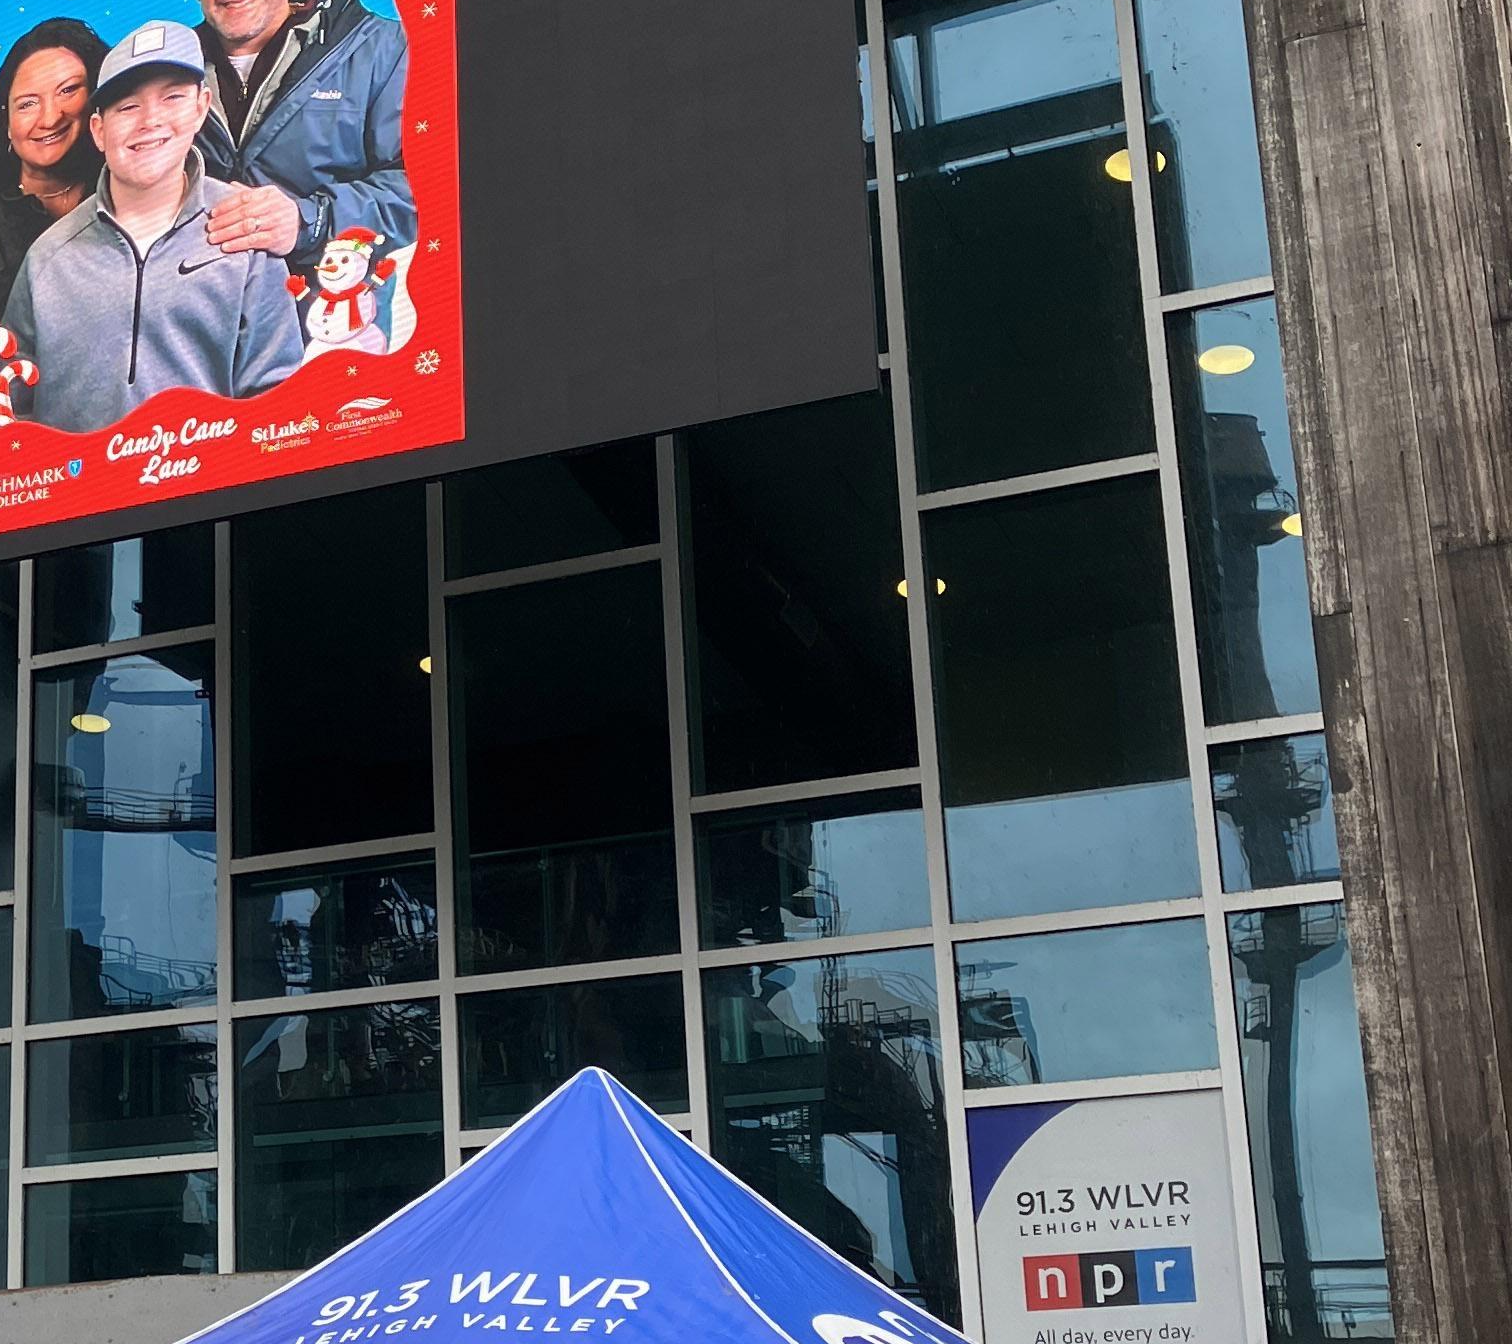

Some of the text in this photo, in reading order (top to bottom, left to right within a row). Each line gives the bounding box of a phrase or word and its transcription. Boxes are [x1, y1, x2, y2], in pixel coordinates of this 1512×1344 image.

[325, 408, 403, 432] Commonwealth
[106, 417, 238, 462] Candy Cane
[139, 454, 202, 485] Lane
[1016, 1180, 1190, 1216] 91.3 WLVR
[1019, 1213, 1191, 1237] LEHIGH VALLEY
[1037, 1258, 1177, 1305] npr
[311, 1271, 650, 1327] 91.3 WLVR
[462, 1312, 627, 1335] VALLEY
[1103, 1328, 1152, 1344] every
[1158, 1323, 1196, 1341] day.
